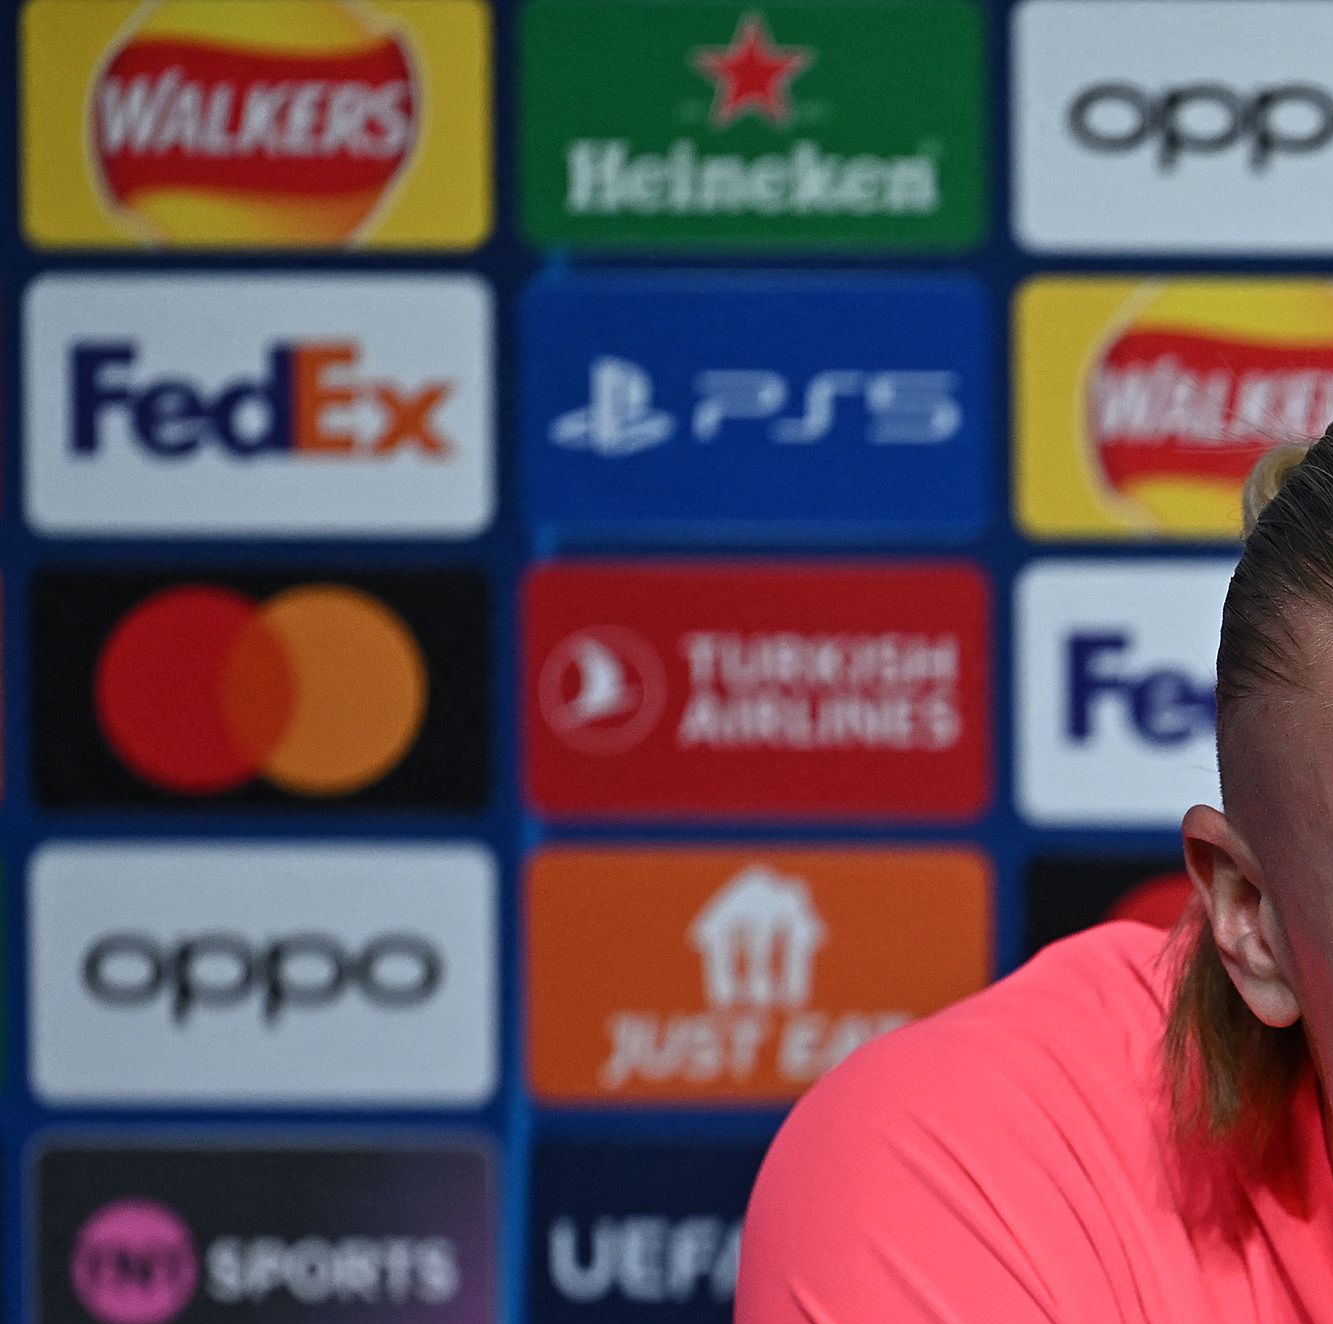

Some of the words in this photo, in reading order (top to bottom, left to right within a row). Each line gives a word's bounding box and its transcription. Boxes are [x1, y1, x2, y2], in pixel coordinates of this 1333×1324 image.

[102, 65, 414, 158] WALKERS
[567, 140, 938, 213] Heineken
[67, 339, 450, 462] FedEx
[693, 370, 961, 443] PS5
[682, 632, 958, 686] TURKISH
[680, 692, 962, 750] AIRLINES
[81, 932, 443, 1028] oppo
[602, 1010, 772, 1090] JUST
[207, 1236, 458, 1304] SPORTS
